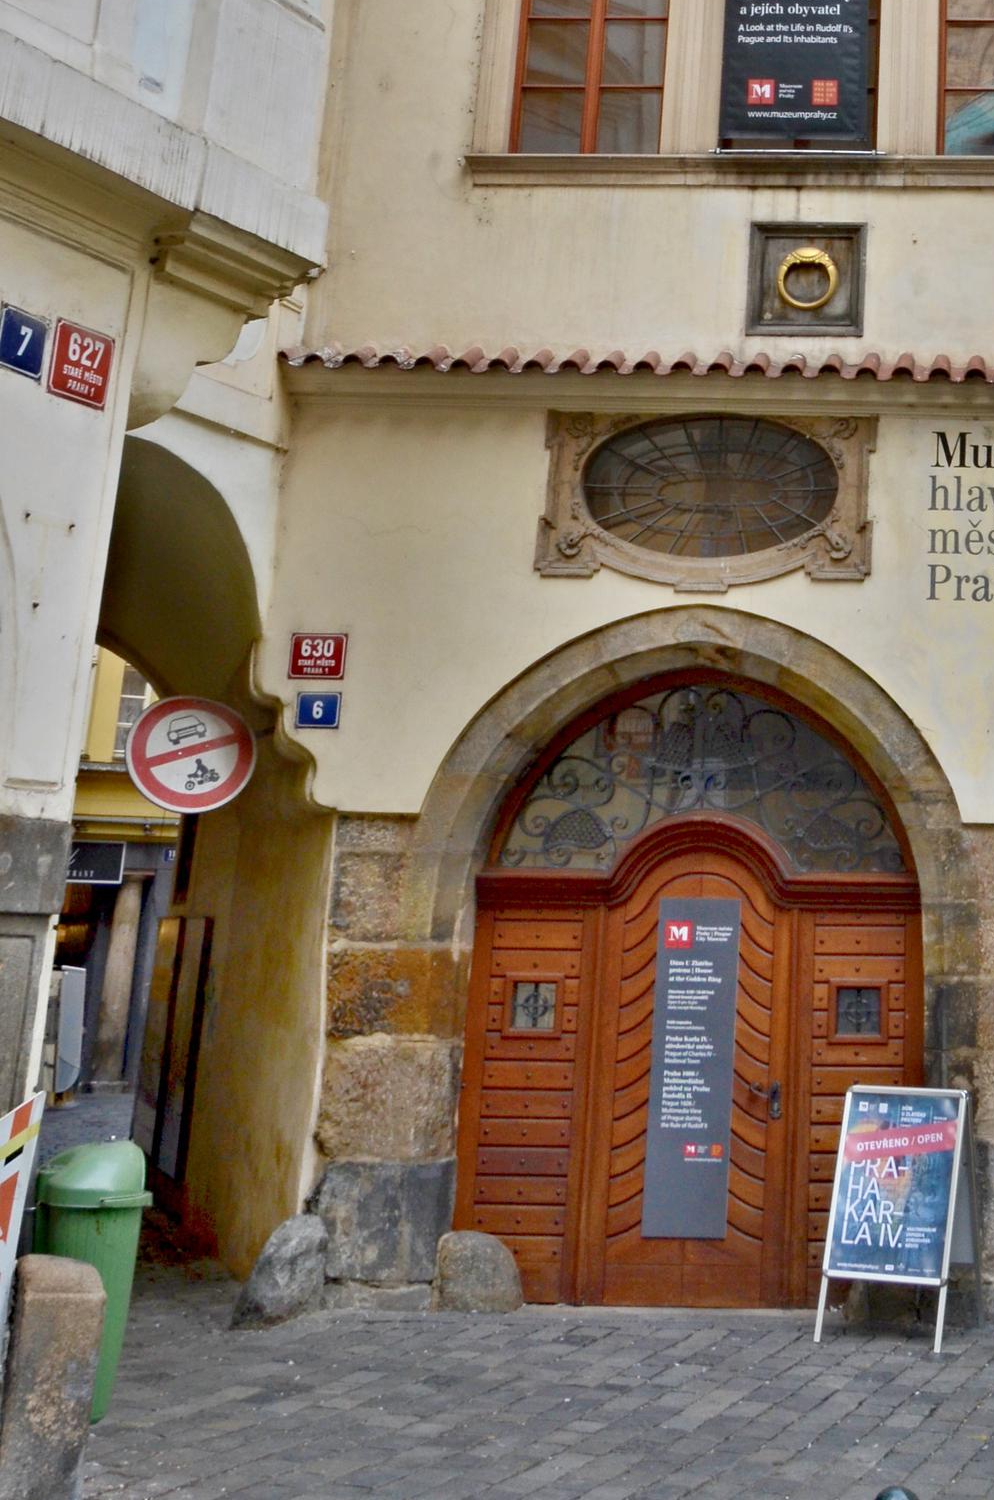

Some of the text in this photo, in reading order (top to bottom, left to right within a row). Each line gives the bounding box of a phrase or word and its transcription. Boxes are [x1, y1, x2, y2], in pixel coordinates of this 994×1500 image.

[740, 3, 840, 17] a jejích obyvatel
[746, 23, 765, 31] Look
[776, 23, 789, 31] the
[790, 23, 805, 31] Life
[816, 24, 842, 32] Rudolf
[737, 35, 838, 44] Prague and Its Inhabitants
[752, 84, 770, 98] M
[747, 110, 837, 120] www.muzeumprahy.cz
[17, 325, 33, 356] 7
[68, 332, 105, 369] 627
[62, 364, 103, 386] STARÉ MĚSTO
[67, 379, 95, 397] PRAHA 1
[301, 639, 334, 657] 630
[312, 701, 324, 719] 6
[668, 926, 688, 941] M
[857, 1137, 909, 1151] OTEVŘENO
[917, 1132, 944, 1144] OPEN
[848, 1176, 880, 1200] HA
[845, 1199, 903, 1224] KAR-
[841, 1221, 872, 1246] LA
[879, 1223, 903, 1248] IV.
